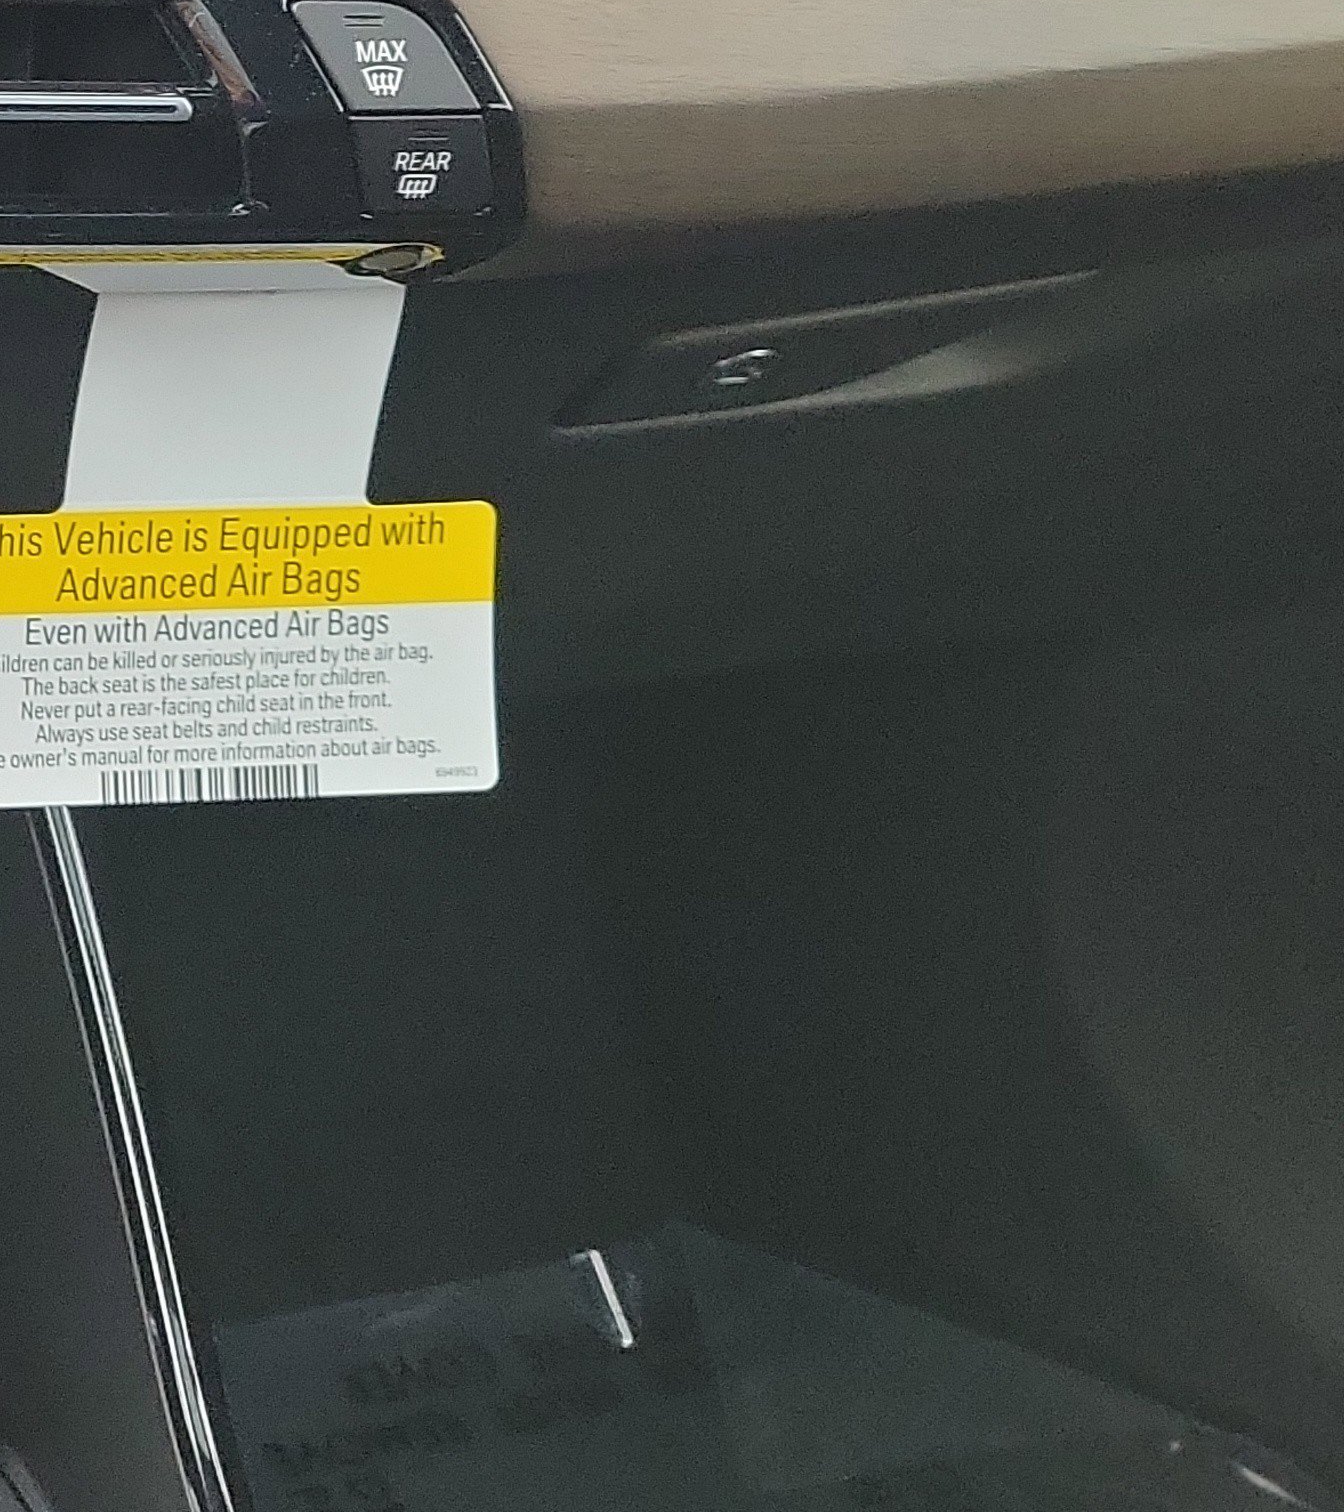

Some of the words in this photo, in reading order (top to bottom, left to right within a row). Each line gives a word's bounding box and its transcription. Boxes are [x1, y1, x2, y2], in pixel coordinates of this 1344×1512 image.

[355, 40, 407, 62] MAX
[395, 151, 451, 171] REAR
[54, 519, 173, 555] Vehicle
[184, 519, 208, 552] is
[220, 514, 371, 558] Equipped
[381, 511, 444, 546] with
[56, 564, 218, 602] Advanced
[227, 563, 272, 597] Air
[283, 561, 360, 602] Bags
[26, 618, 86, 645] Even
[94, 615, 146, 643] with
[154, 611, 279, 642] Advanced
[286, 611, 320, 637] Air
[328, 609, 389, 641] Bags
[53, 656, 83, 672] can
[88, 652, 108, 670] be
[113, 650, 156, 669] killed
[162, 653, 179, 668] or
[182, 647, 256, 669] seriously
[261, 646, 315, 669] injured
[320, 646, 339, 666] by
[345, 644, 370, 662] the
[374, 643, 394, 660] air
[399, 642, 433, 663] bag.
[22, 677, 54, 696] The
[59, 675, 98, 695] back
[102, 677, 138, 693] seat
[143, 674, 155, 692] is
[160, 673, 186, 691] the
[191, 673, 240, 690] safest
[245, 672, 289, 692] place
[294, 669, 316, 685] for
[320, 667, 389, 685] children.
[21, 701, 70, 720] Never
[75, 701, 102, 722] put
[107, 703, 115, 716] a
[120, 697, 212, 718] rear-facing
[216, 694, 255, 713] child
[260, 695, 295, 712] seat
[300, 692, 312, 710] in
[318, 692, 344, 709] the
[349, 691, 392, 708] front.
[35, 724, 94, 747] Always
[99, 727, 128, 741] use
[133, 723, 167, 739] seat
[174, 721, 213, 737] belts
[218, 719, 247, 737] and
[252, 716, 291, 735] child
[296, 715, 378, 734] restraints.
[10, 748, 76, 768] owner's
[82, 746, 142, 765] manual
[147, 745, 169, 763] for
[174, 746, 218, 762] more
[222, 742, 315, 760] information
[321, 740, 368, 757] about
[372, 737, 393, 755] air
[397, 737, 441, 758] bags.
